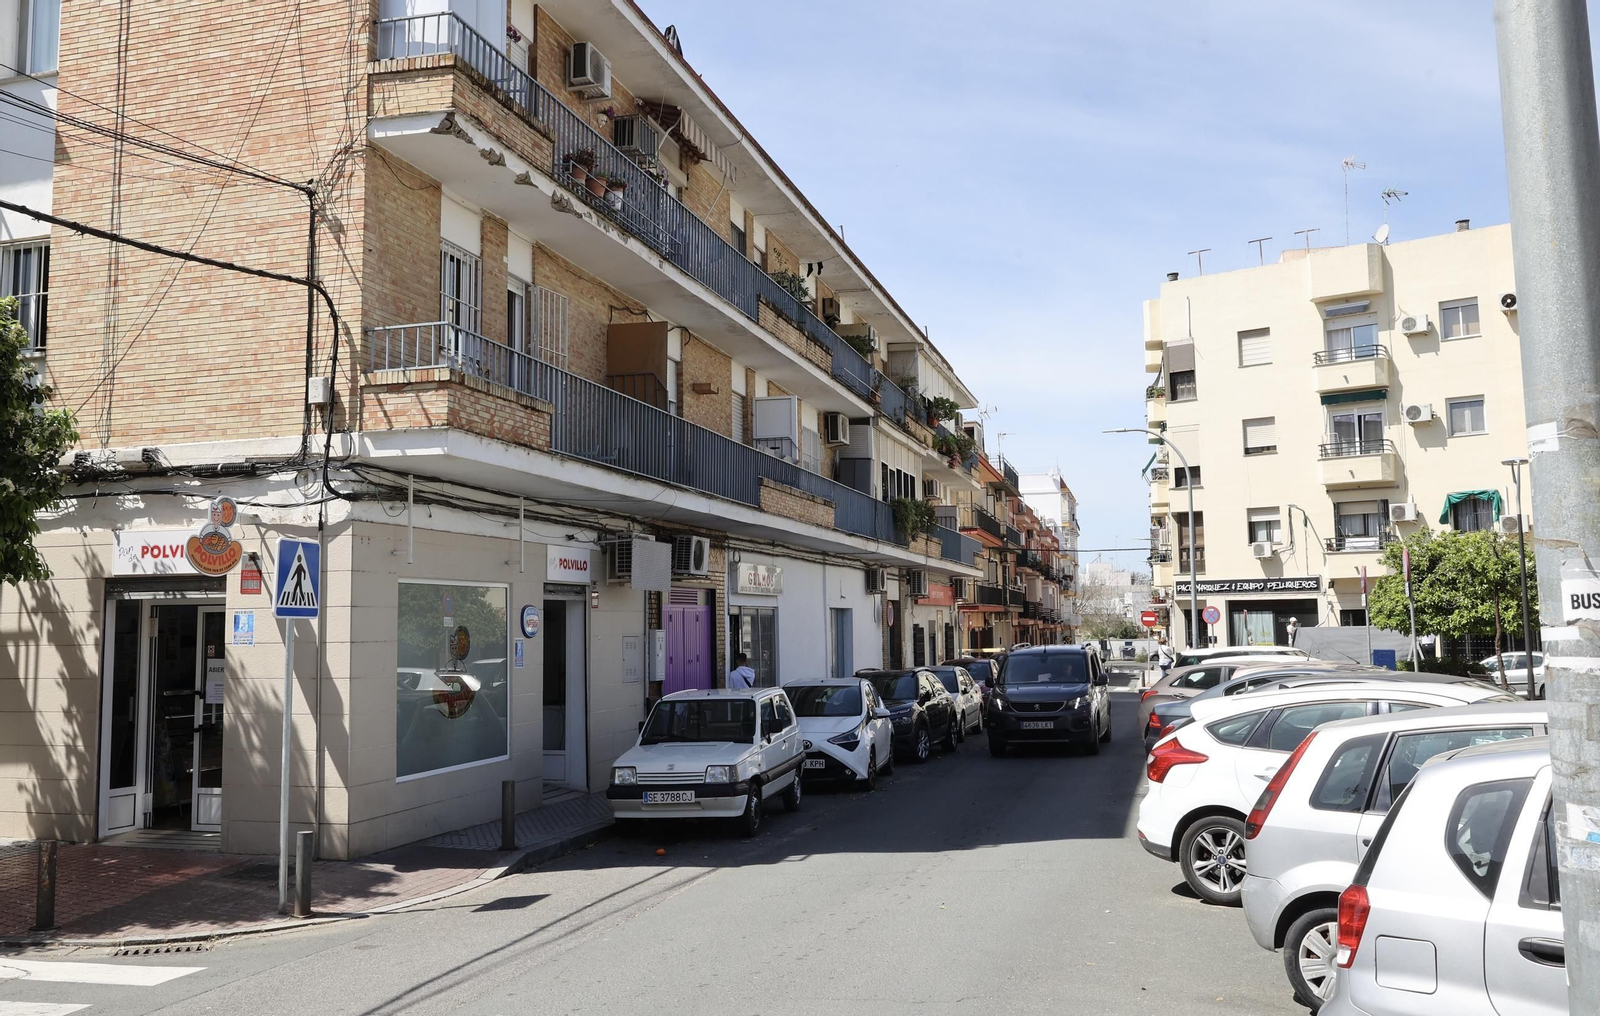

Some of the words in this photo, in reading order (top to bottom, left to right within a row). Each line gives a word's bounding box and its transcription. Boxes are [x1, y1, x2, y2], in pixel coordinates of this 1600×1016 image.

[141, 544, 184, 559] POLVI
[194, 544, 236, 566] POLVILLO
[559, 558, 588, 572] POLVILLO
[1236, 582, 1264, 590] EQUIPO
[1267, 580, 1318, 590] PELUQUEROS
[1570, 592, 1600, 610] BUS
[647, 792, 658, 802] SE
[660, 792, 680, 802] 3788
[682, 791, 693, 801] CJ
